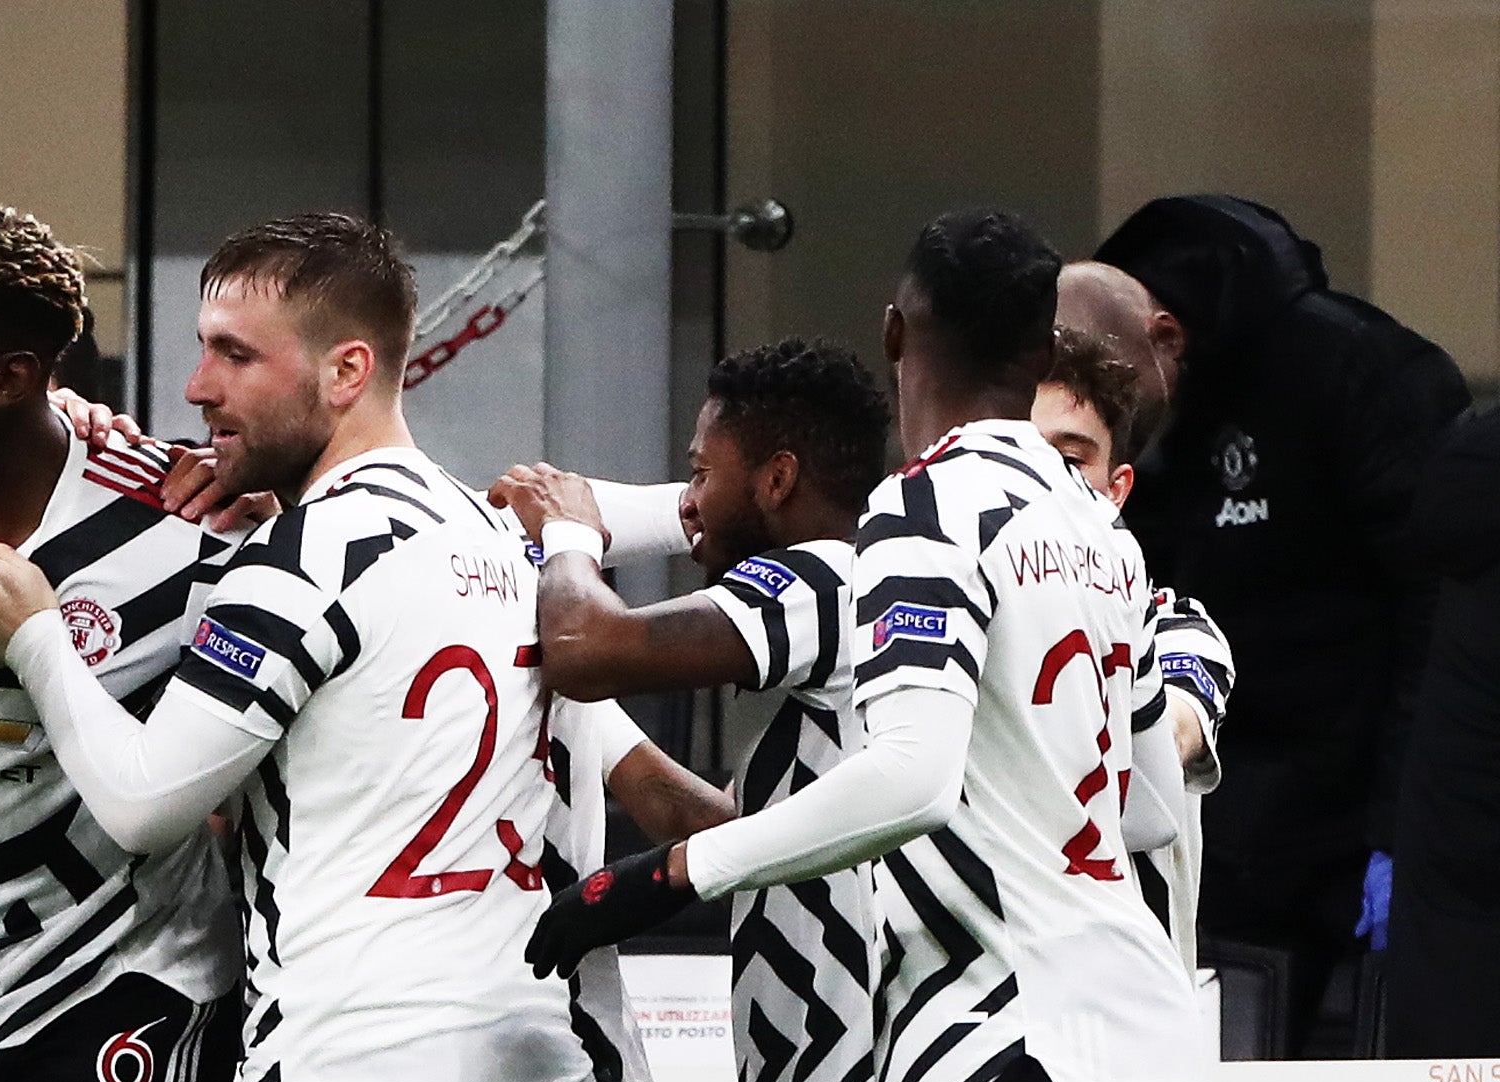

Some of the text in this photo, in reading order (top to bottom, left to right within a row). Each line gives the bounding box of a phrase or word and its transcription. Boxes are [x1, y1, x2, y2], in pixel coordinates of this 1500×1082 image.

[1216, 499, 1268, 527] AON
[451, 554, 518, 606] SHAW
[60, 601, 112, 632] ANCHESTER
[886, 611, 946, 631] SPECT
[204, 632, 262, 673] RESPECT
